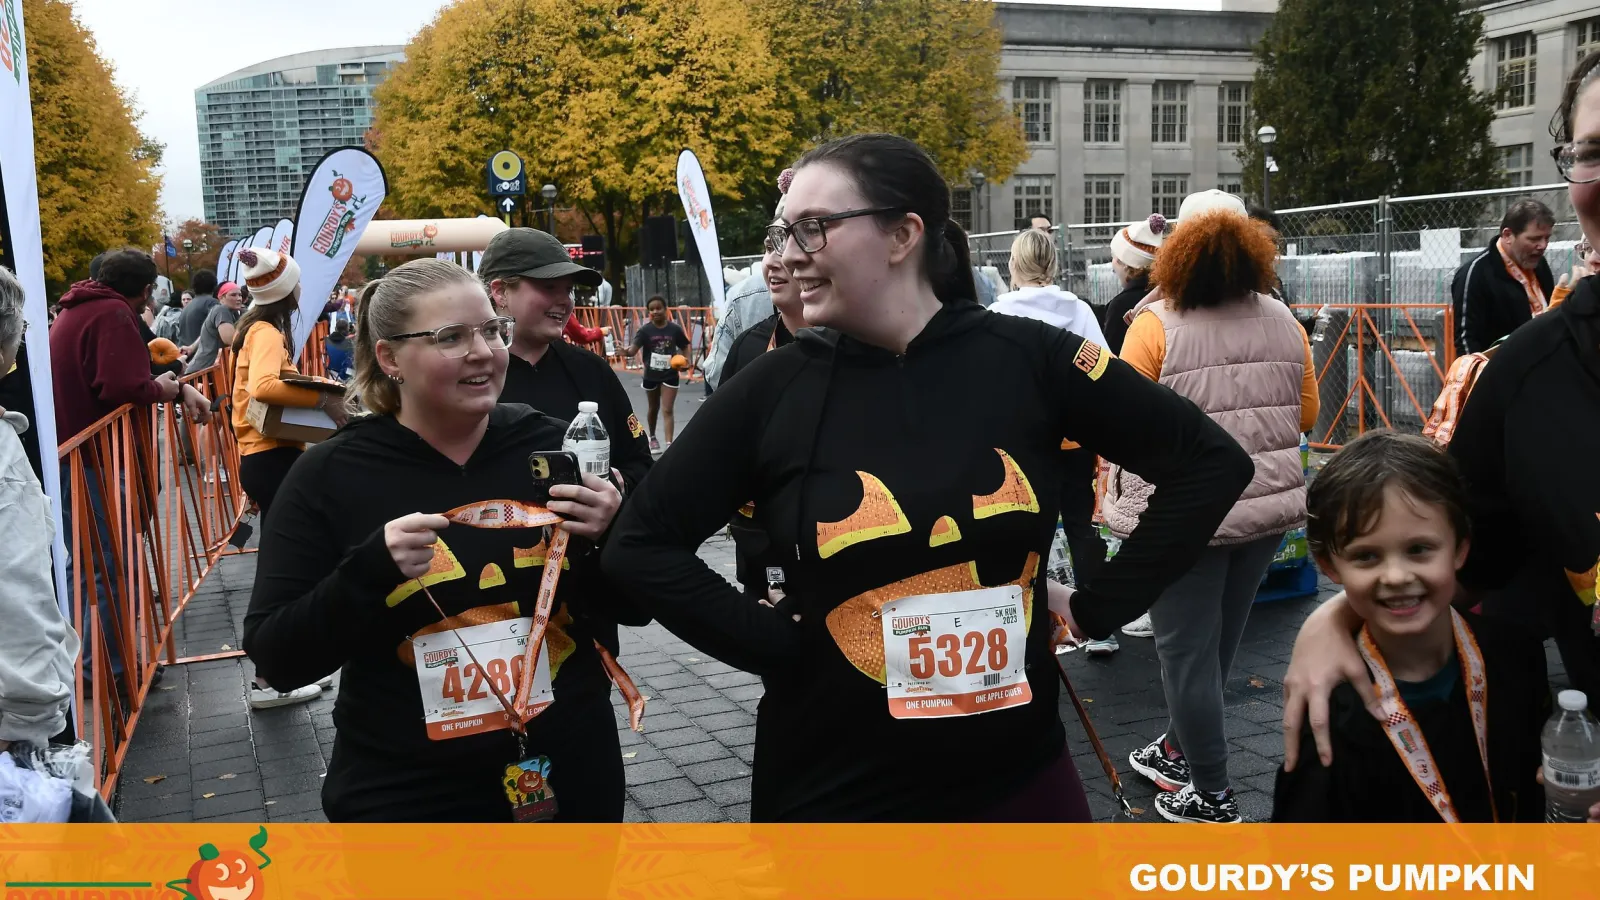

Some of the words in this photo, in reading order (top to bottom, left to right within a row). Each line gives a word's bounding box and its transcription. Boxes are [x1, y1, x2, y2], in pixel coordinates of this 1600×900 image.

[312, 202, 347, 254] GOURDY'S
[1075, 340, 1101, 373] GOUR
[995, 609, 1004, 618] 5K
[1005, 606, 1017, 615] RUN
[892, 615, 931, 629] GOURDY'S
[954, 617, 962, 628] E
[1003, 615, 1018, 625] 2023
[517, 637, 525, 646] 5K
[424, 648, 458, 662] GOURDY'S
[908, 628, 1008, 679] 5328
[975, 694, 987, 703] ONE
[987, 690, 1004, 701] APPLE
[1005, 686, 1023, 698] CIDER
[905, 700, 920, 710] ONE
[921, 698, 953, 708] PUMPKIN
[442, 723, 454, 732] ONE
[455, 718, 484, 729] PUMPKIN
